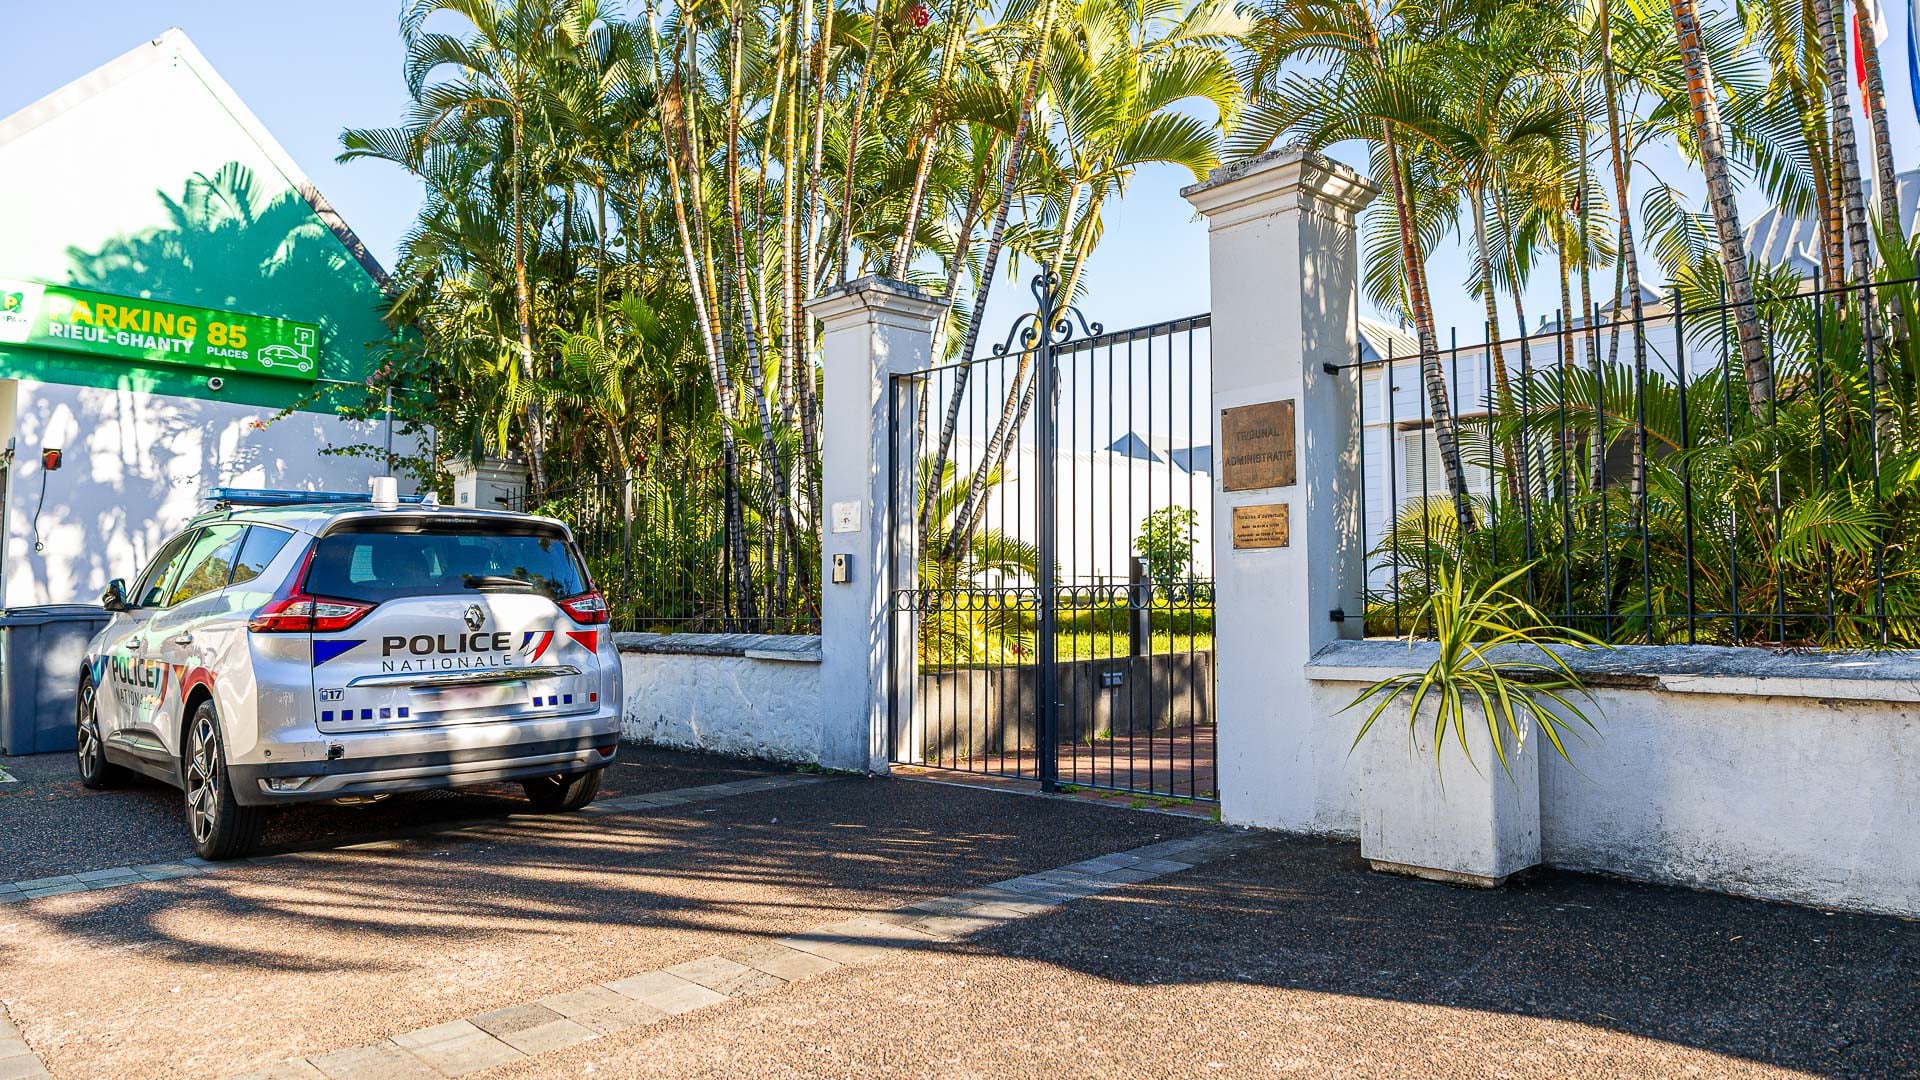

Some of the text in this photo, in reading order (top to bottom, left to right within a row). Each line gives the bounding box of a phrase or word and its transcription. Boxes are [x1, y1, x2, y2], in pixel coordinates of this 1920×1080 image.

[48, 297, 247, 348] PARKING 85
[49, 322, 194, 354] RIEUL-GHANTY
[301, 332, 309, 341] P
[206, 346, 249, 360] PLACES
[1236, 427, 1280, 442] TRIBUNAL
[1225, 450, 1293, 467] ADMINISTRATIF
[382, 632, 511, 656] POLICE
[112, 655, 154, 688] POLICE
[382, 655, 512, 672] NATIONALE
[329, 690, 342, 700] 17
